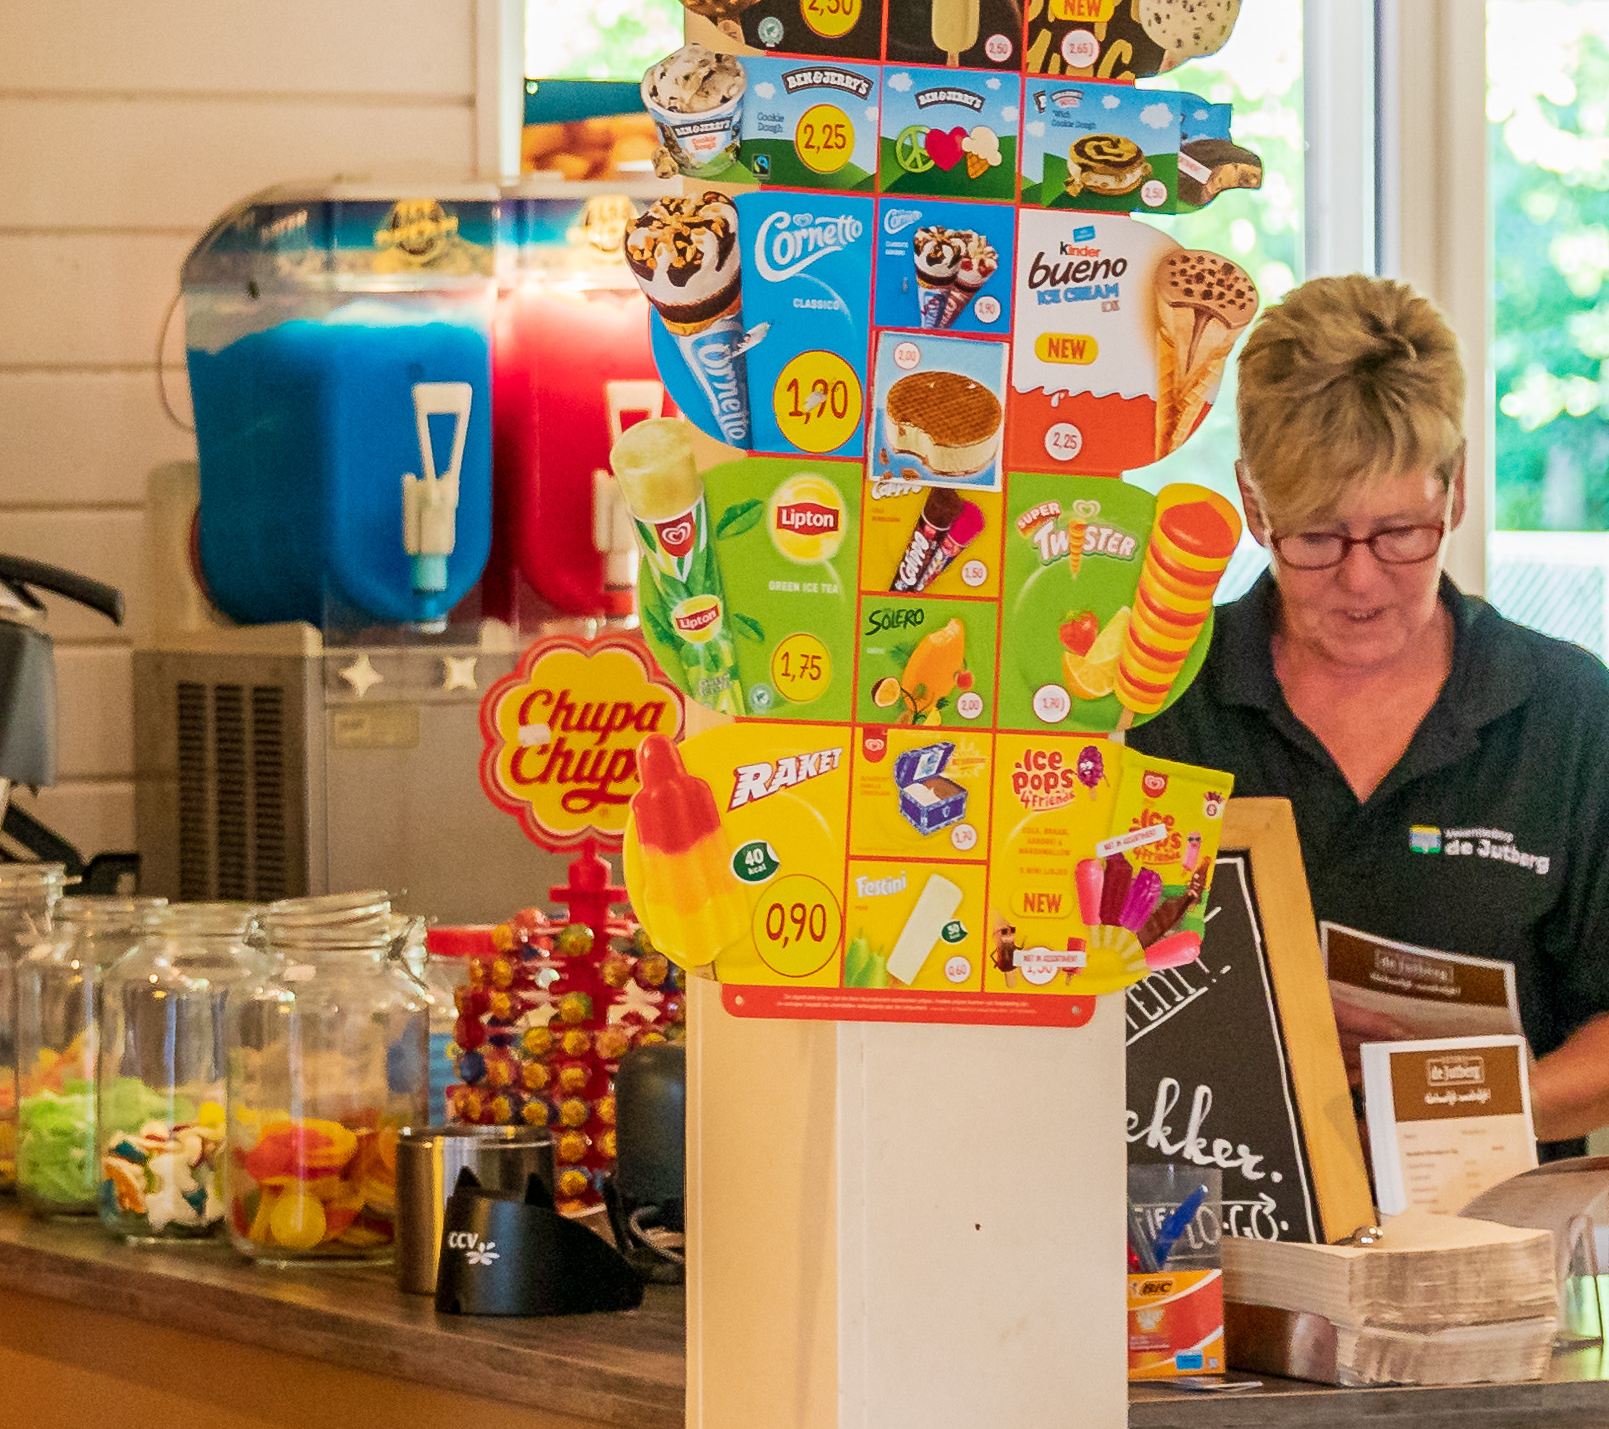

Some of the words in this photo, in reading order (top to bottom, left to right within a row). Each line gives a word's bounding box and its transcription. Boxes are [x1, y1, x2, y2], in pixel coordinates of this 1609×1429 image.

[757, 111, 784, 122] Cookie
[803, 123, 847, 153] 2,25
[754, 210, 863, 283] Cornetto
[1059, 241, 1101, 258] kinder
[1027, 251, 1128, 289] bueno
[793, 298, 840, 311] CLASSICO
[1037, 288, 1061, 305] ICE
[1063, 282, 1119, 303] CREAM
[1047, 337, 1087, 360] NEW
[781, 508, 835, 529] Lipton
[1016, 501, 1062, 531] SUPER
[768, 580, 800, 592] GREEN
[802, 581, 818, 593] ICE
[821, 582, 839, 594] TEA
[679, 609, 717, 630] Lipton
[864, 608, 925, 636] SOLERO
[781, 651, 823, 682] 1,75
[518, 689, 667, 745] Chupa
[1017, 749, 1063, 771] Ice
[510, 737, 640, 813] Chup
[726, 747, 844, 813] RAKET
[1012, 770, 1075, 795] pops
[744, 847, 764, 866] 40
[1444, 838, 1473, 856] de
[1476, 838, 1550, 875] Jutberg
[747, 863, 768, 876] kcal
[855, 870, 907, 898] Festini
[1023, 892, 1062, 914] NEW
[765, 902, 827, 949] 0,90
[1126, 1077, 1283, 1183] ekker.
[448, 1231, 479, 1249] CCV
[1139, 1279, 1173, 1296] BIC
